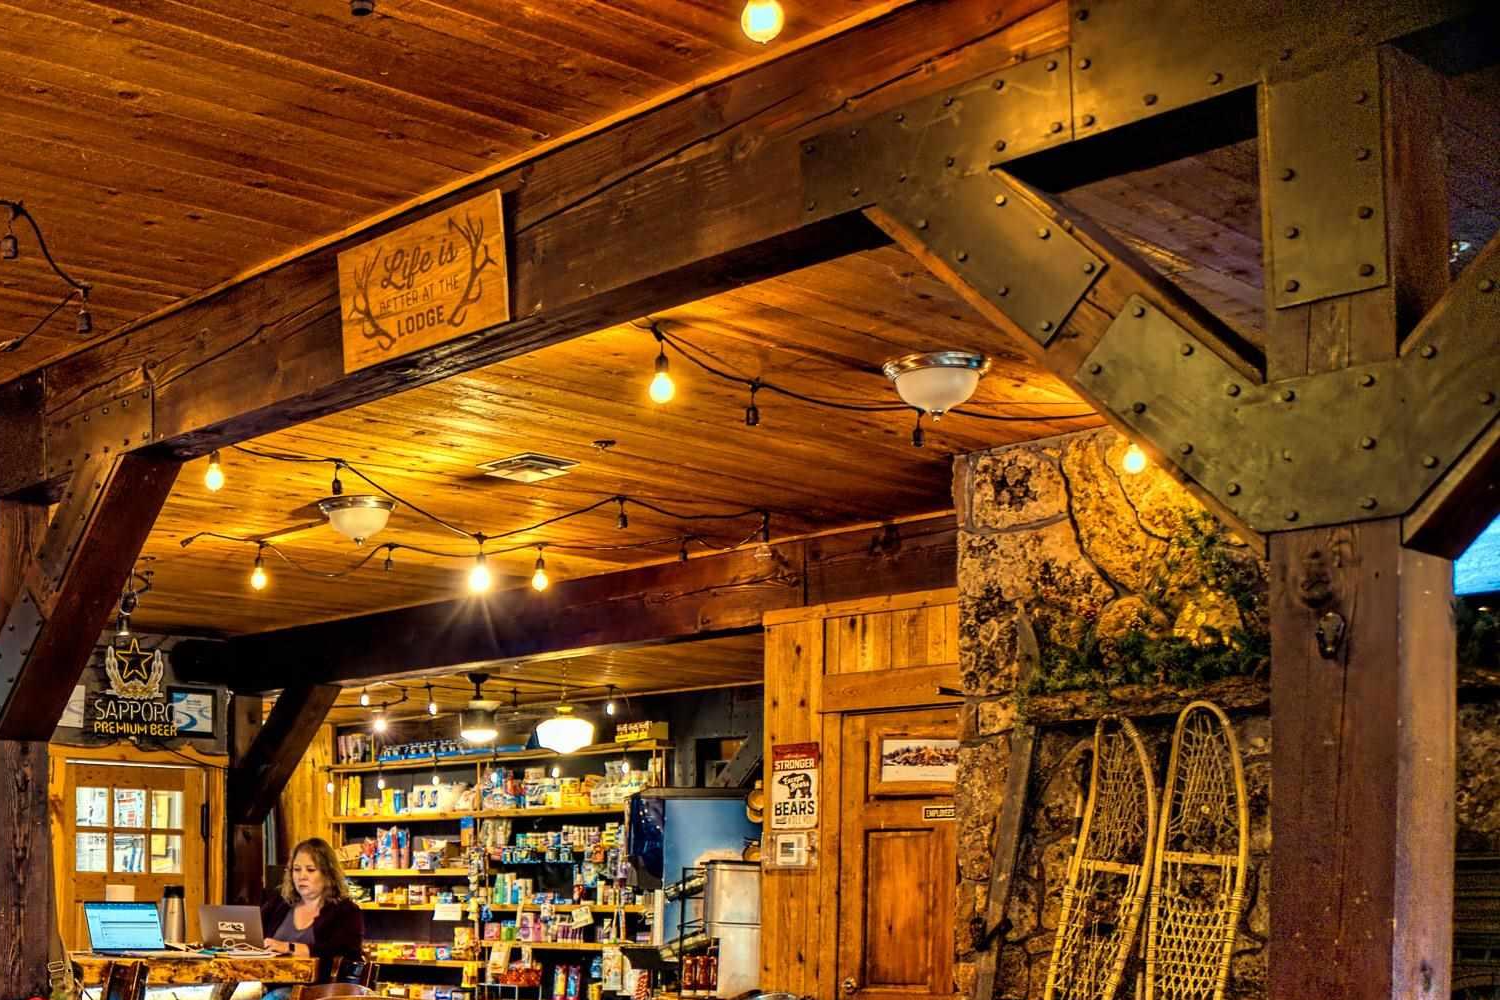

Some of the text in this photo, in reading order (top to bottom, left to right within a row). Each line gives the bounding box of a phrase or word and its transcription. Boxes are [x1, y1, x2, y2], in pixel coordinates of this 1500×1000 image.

[381, 238, 458, 290] Life is
[380, 274, 459, 313] BETTER AT THE
[397, 305, 445, 337] LODGE
[94, 721, 178, 736] PREMIUM BEER
[774, 758, 815, 770] STRONGER
[774, 800, 815, 816] BEARS
